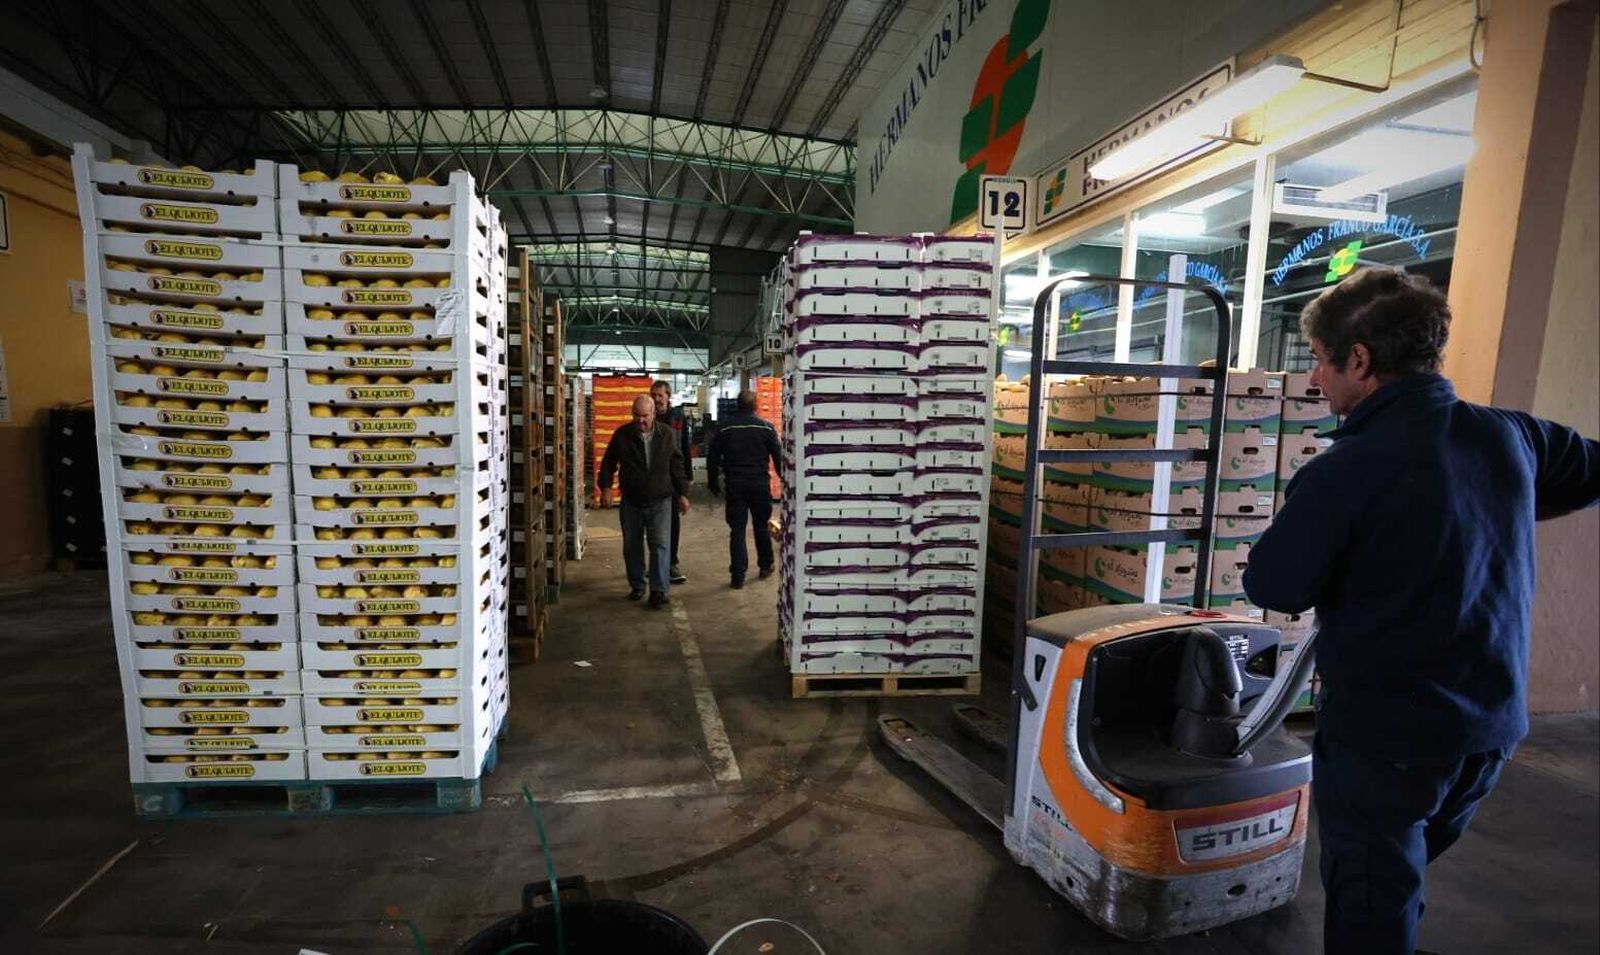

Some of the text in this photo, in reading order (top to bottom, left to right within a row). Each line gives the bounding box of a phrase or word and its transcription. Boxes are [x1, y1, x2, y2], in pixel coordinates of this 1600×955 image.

[988, 190, 1020, 217] 12
[1271, 228, 1323, 287] HERMANOS
[768, 338, 782, 349] 10
[1192, 818, 1283, 852] STILL
